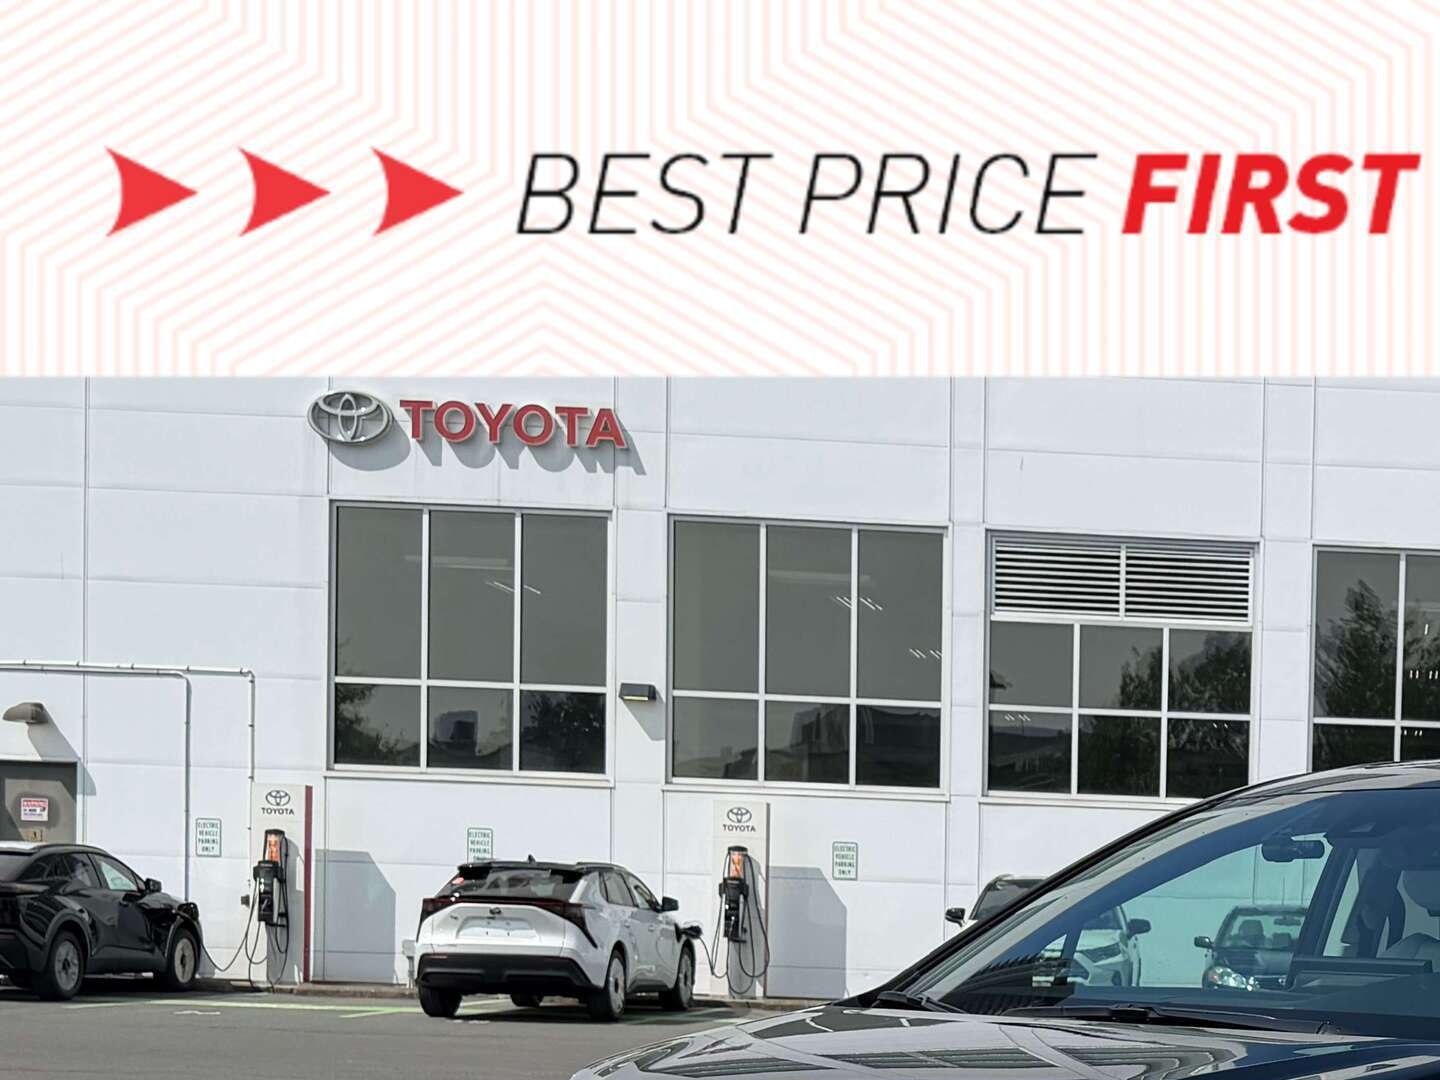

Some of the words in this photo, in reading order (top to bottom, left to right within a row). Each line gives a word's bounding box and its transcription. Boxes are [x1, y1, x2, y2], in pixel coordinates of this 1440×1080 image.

[399, 399, 628, 449] TOYOTA
[261, 807, 295, 815] TOYOTA
[723, 824, 756, 832] TOYOTA
